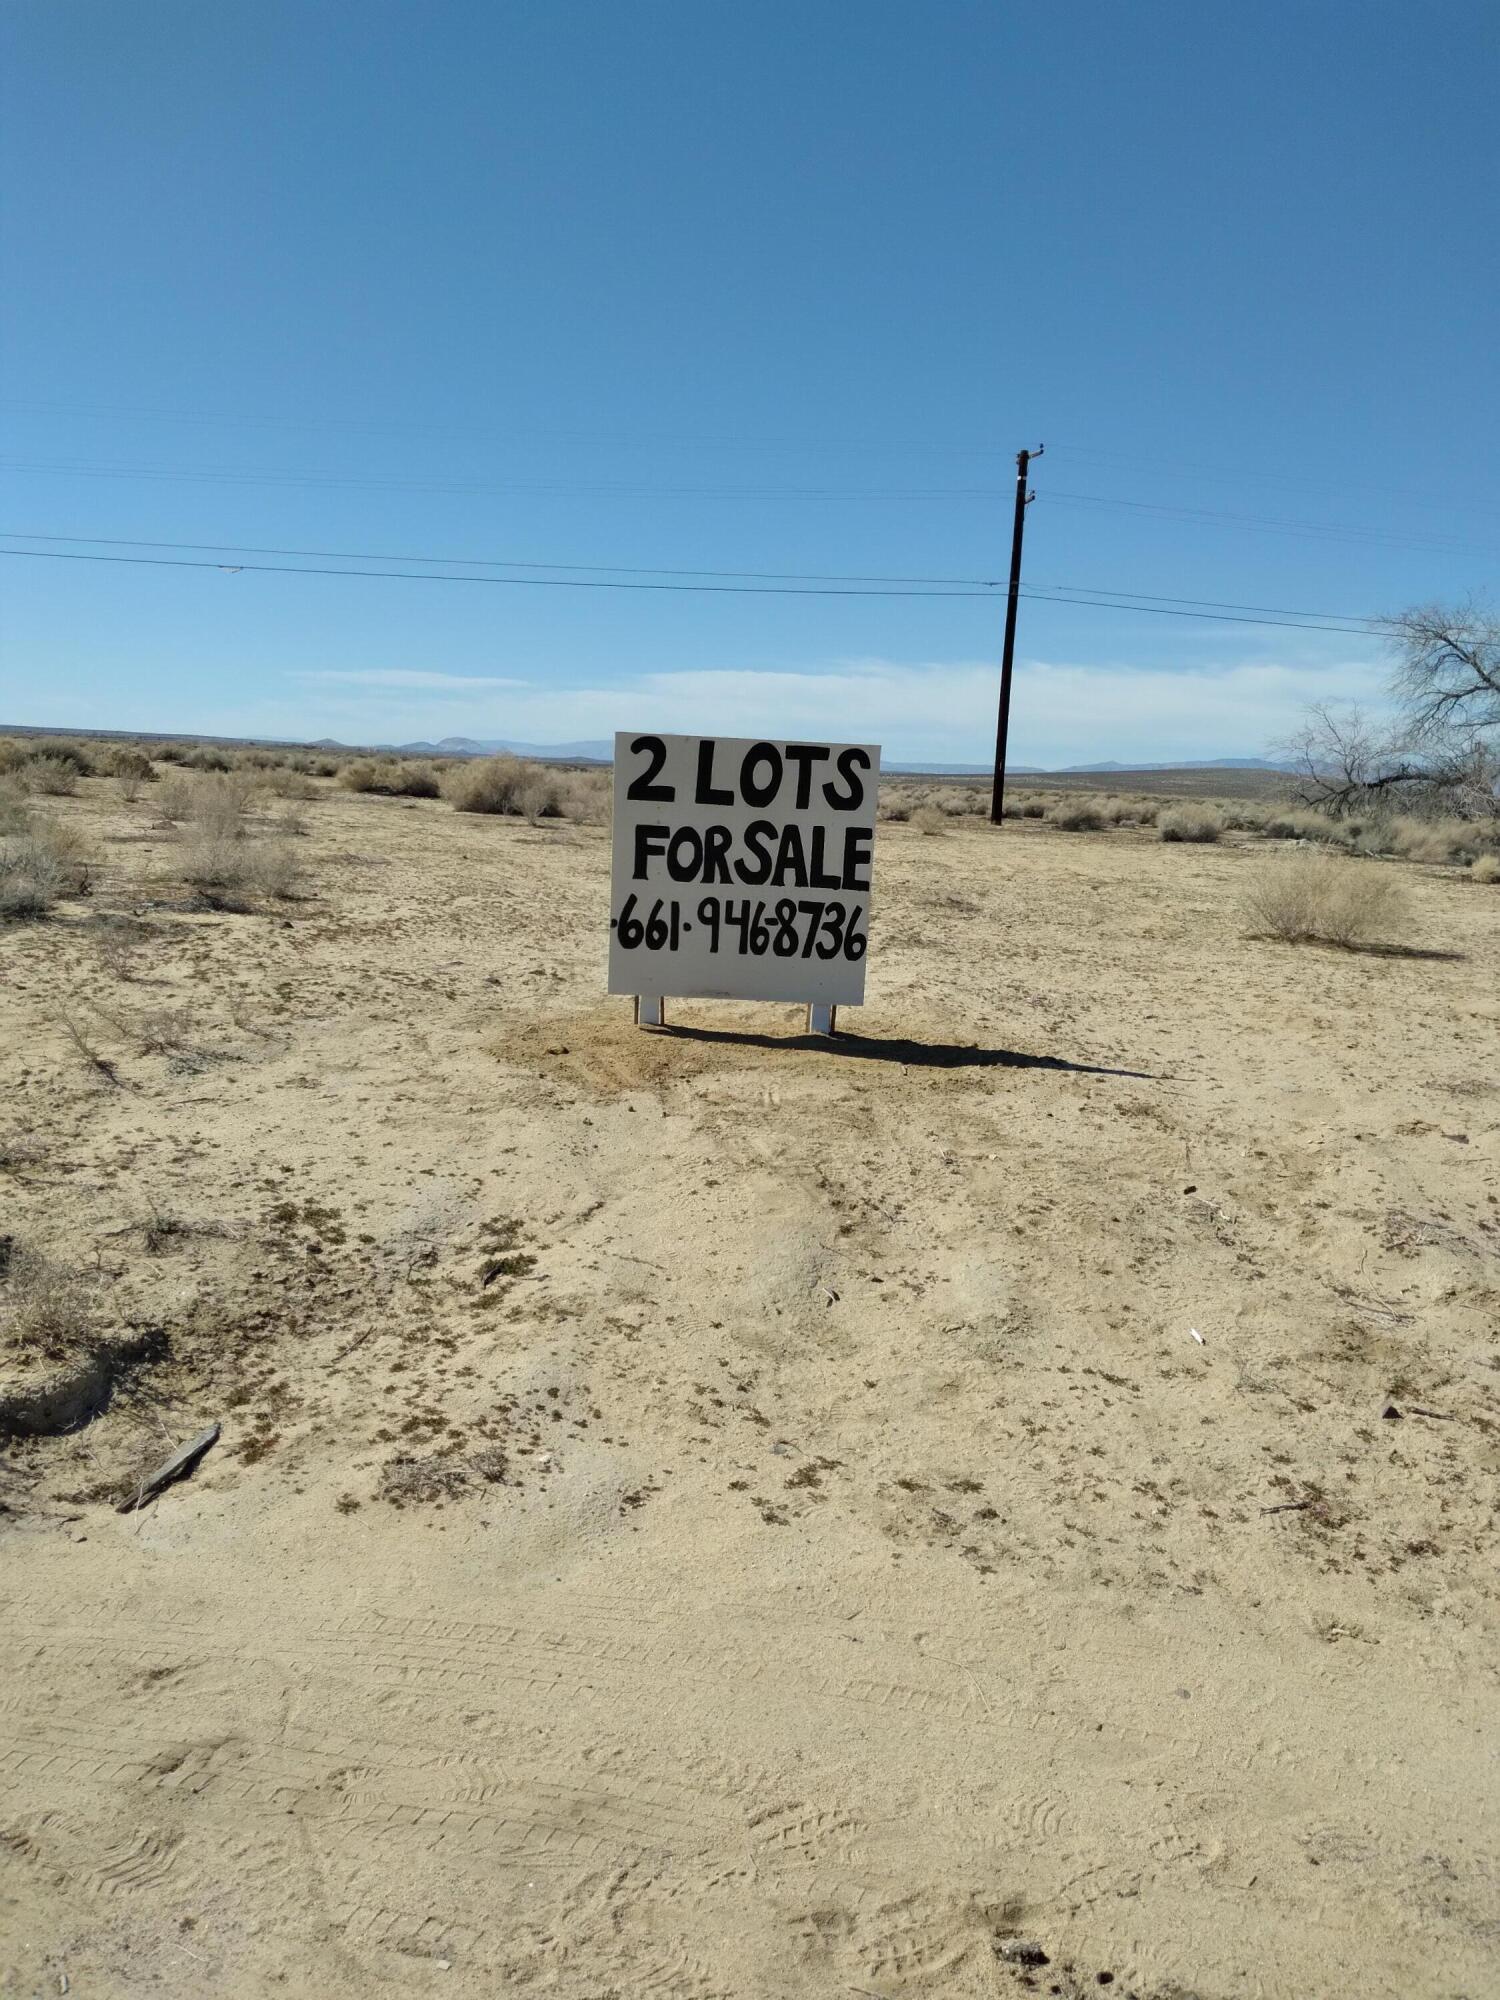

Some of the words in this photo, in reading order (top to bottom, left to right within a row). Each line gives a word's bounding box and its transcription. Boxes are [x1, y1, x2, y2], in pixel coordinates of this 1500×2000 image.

[627, 736, 675, 803] 2
[695, 740, 871, 811] LOTS
[632, 824, 734, 885] FOR
[733, 820, 873, 892] SALE
